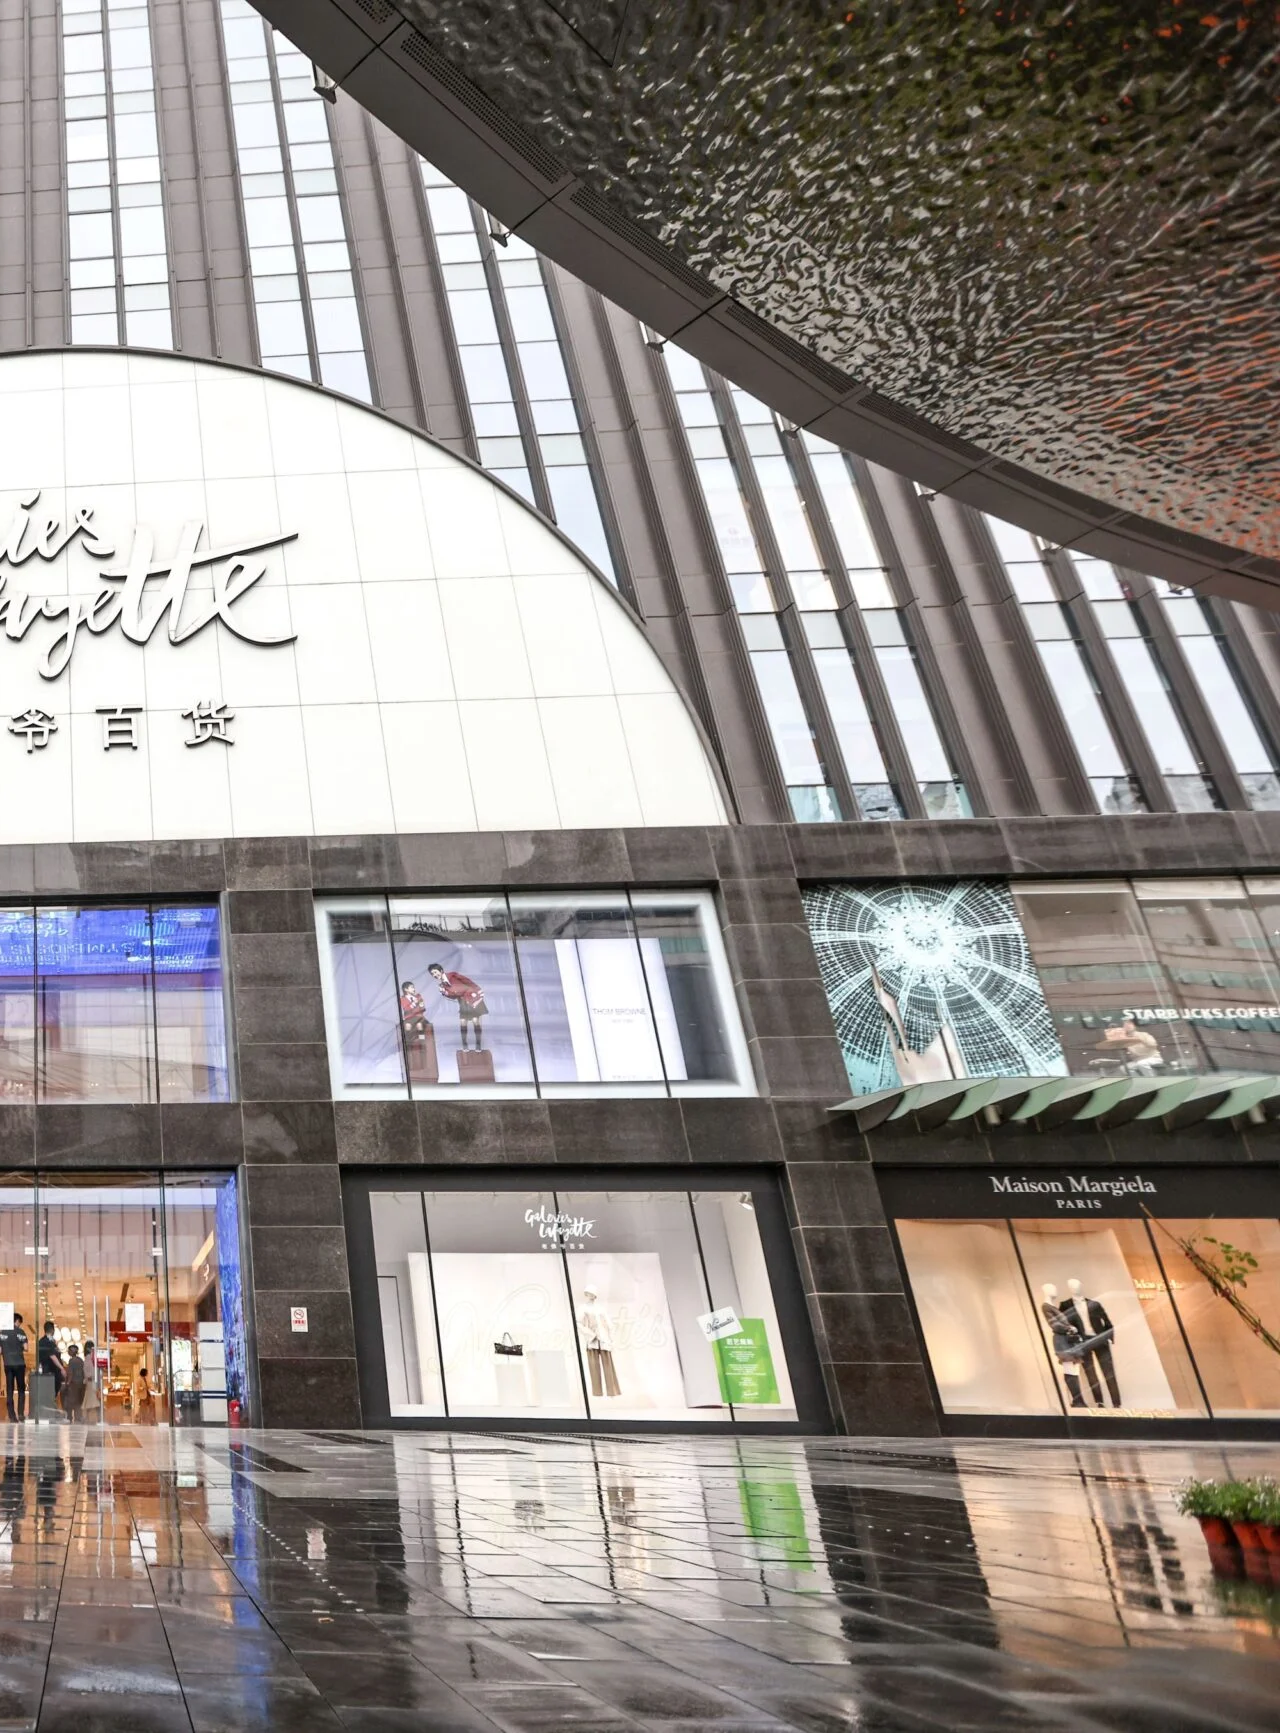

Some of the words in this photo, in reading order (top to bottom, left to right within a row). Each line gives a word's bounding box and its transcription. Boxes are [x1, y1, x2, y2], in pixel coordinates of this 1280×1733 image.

[1122, 1008, 1224, 1019] STARBUCKS
[1225, 1007, 1280, 1018] COFFE
[988, 1176, 1065, 1193] Maison
[1066, 1175, 1157, 1196] Margiela
[1056, 1199, 1102, 1209] PARIS
[524, 1205, 572, 1228] Galeries
